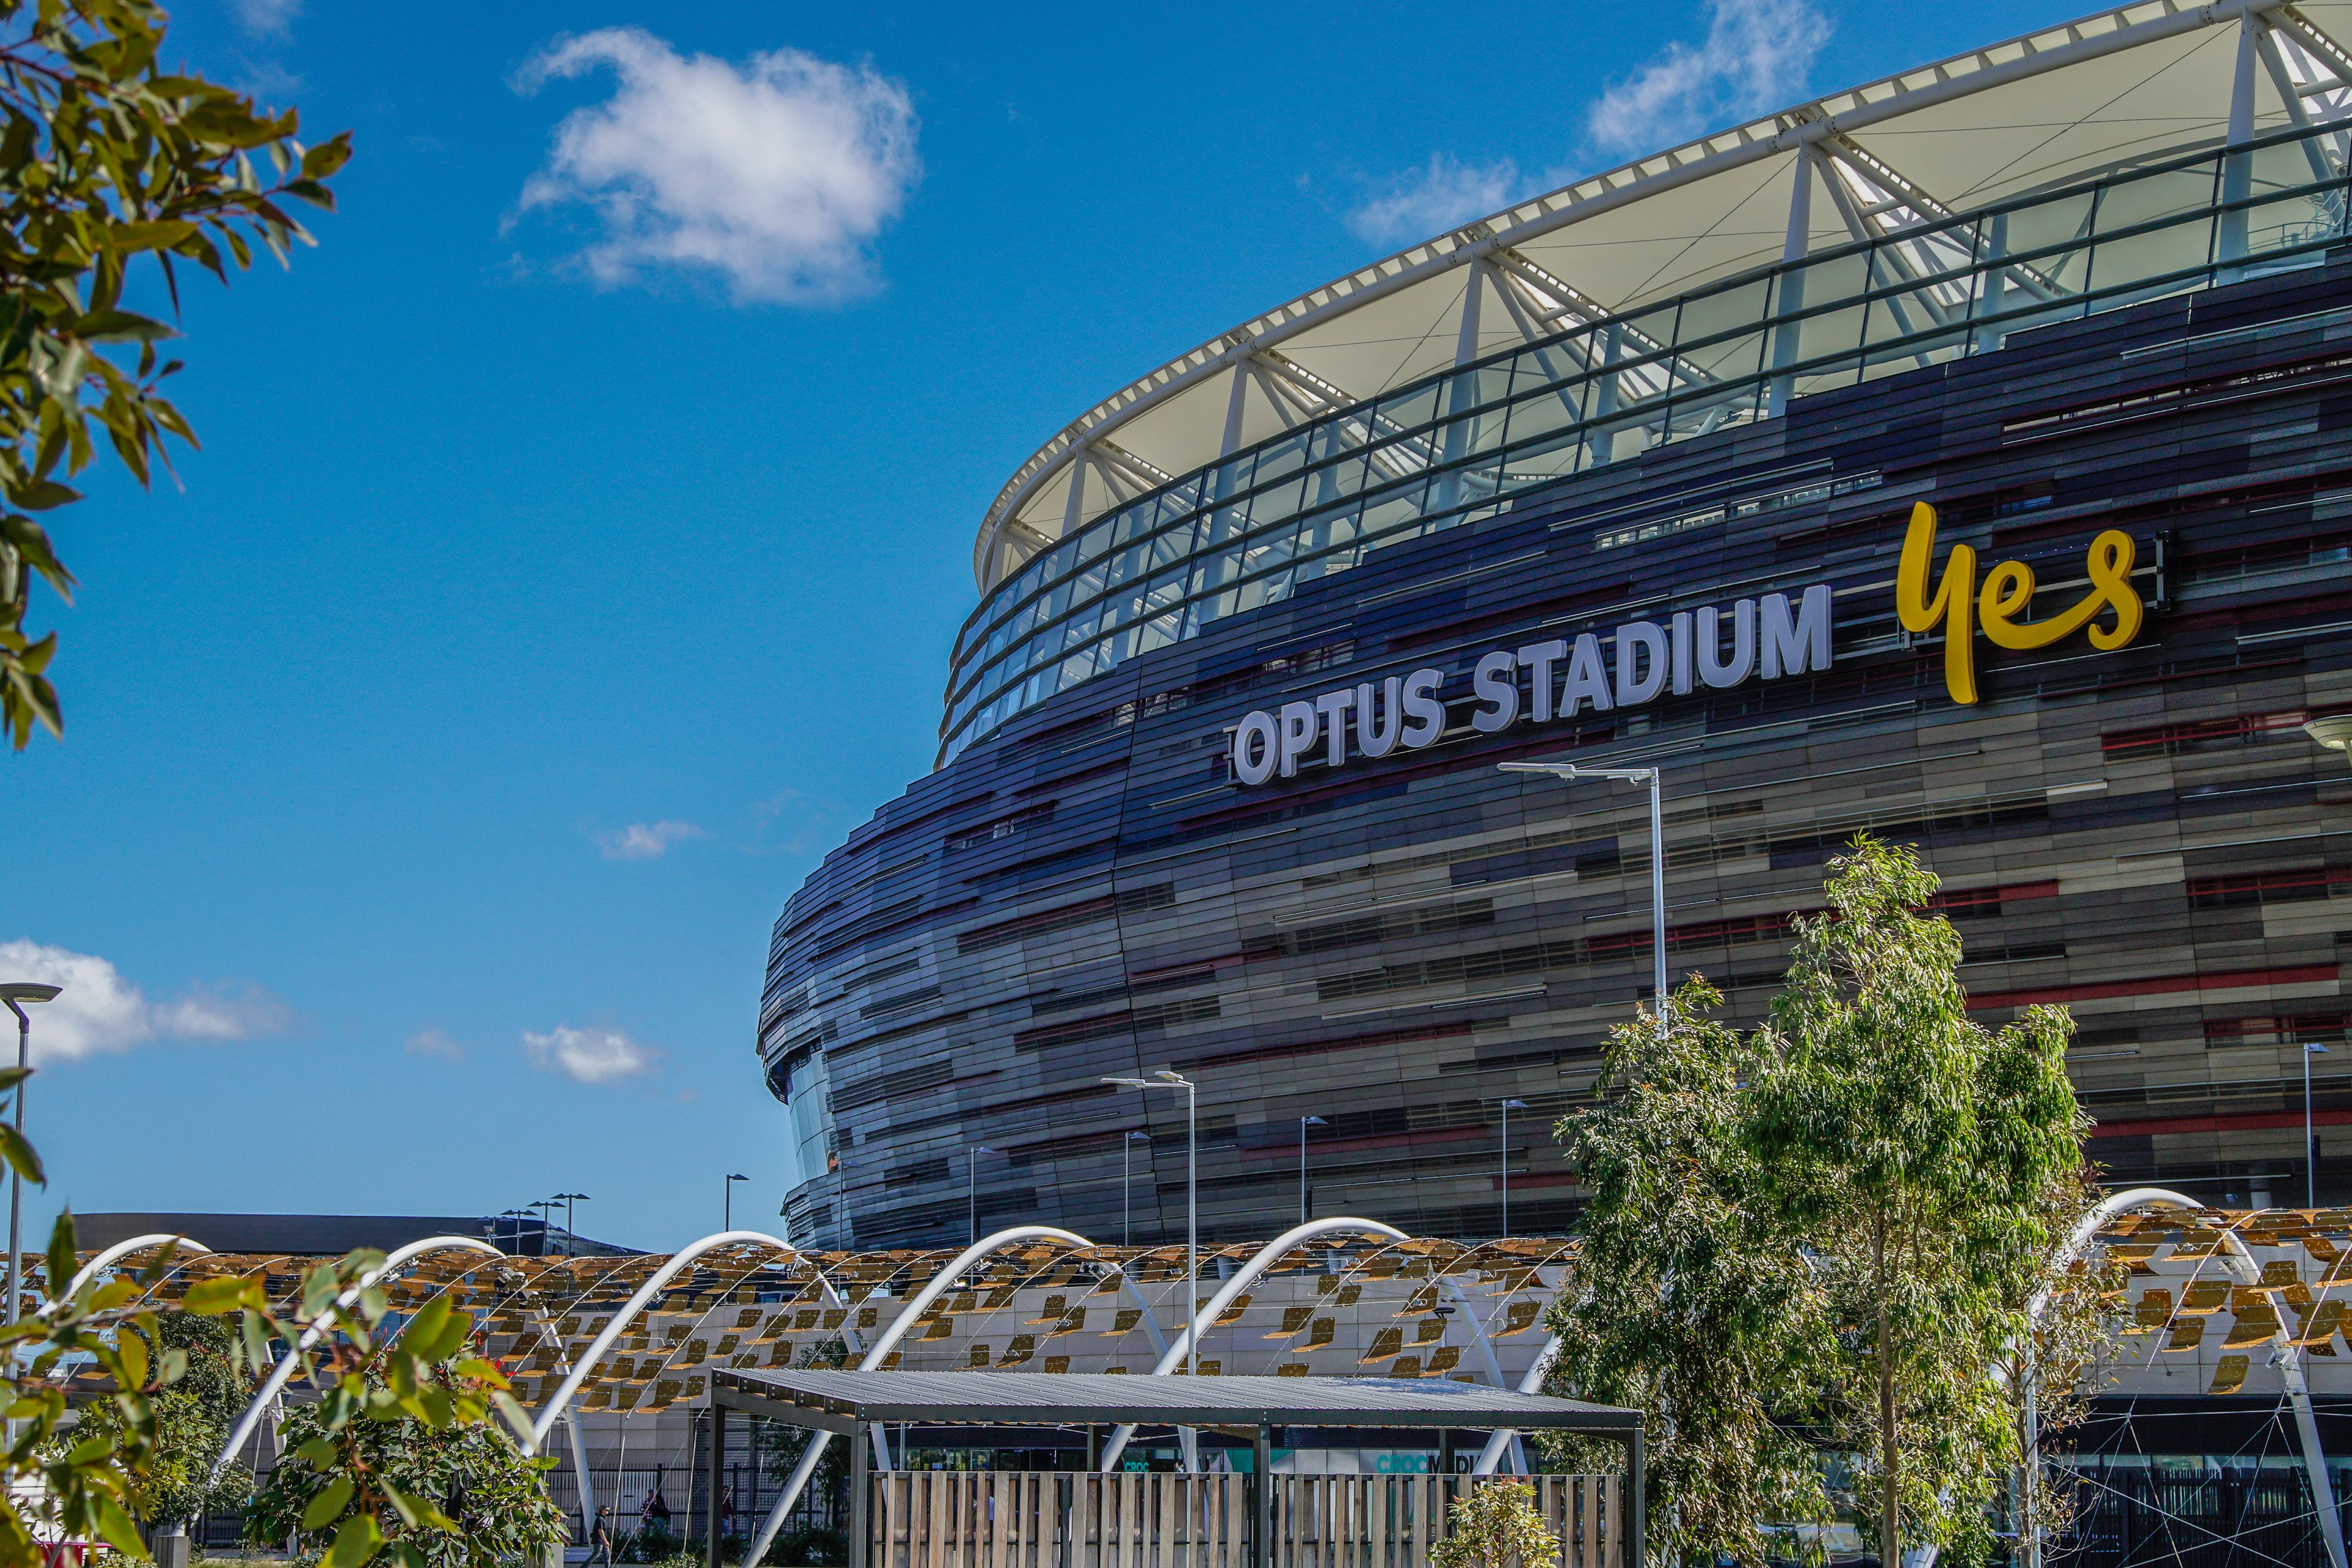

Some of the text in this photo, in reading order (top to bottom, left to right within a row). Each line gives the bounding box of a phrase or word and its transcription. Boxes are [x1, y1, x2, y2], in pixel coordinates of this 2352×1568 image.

[1896, 501, 2143, 704] yes
[1234, 584, 1833, 785] OPTUS STADIUM
[1125, 1462, 1149, 1472] CROC
[1377, 1455, 1481, 1474] CROCMDI
